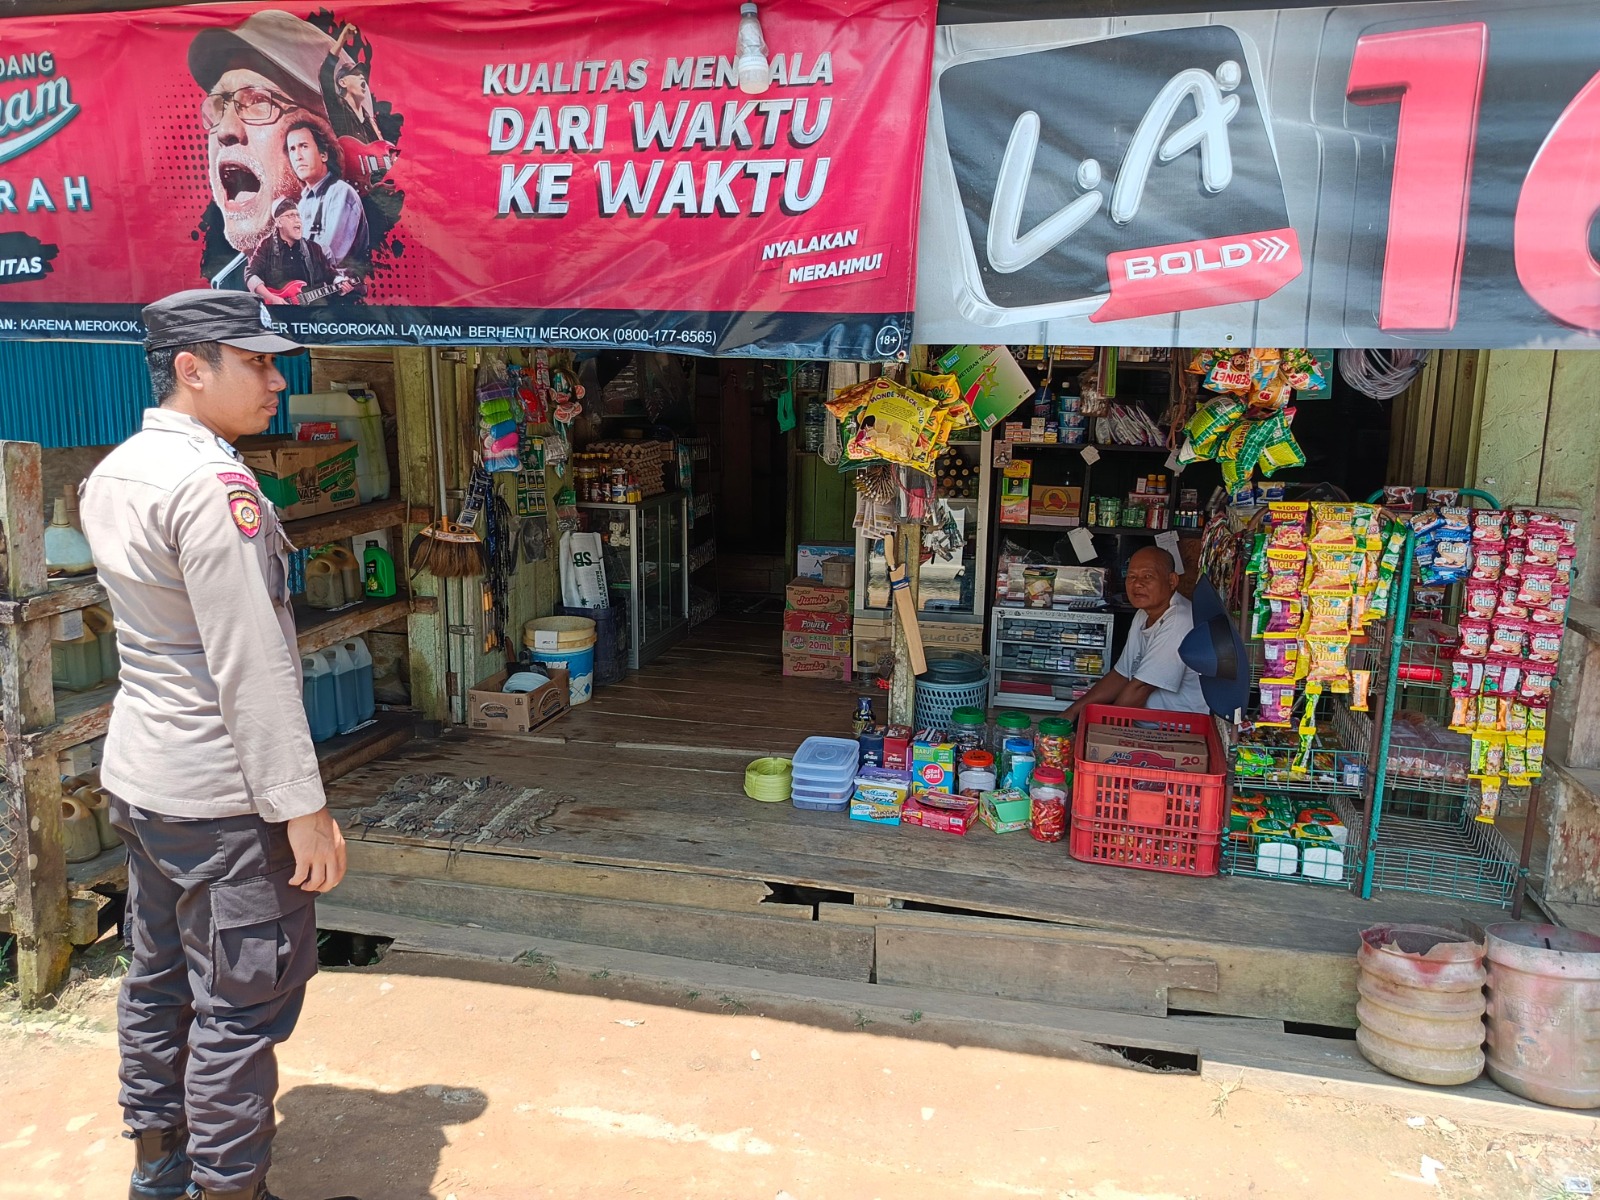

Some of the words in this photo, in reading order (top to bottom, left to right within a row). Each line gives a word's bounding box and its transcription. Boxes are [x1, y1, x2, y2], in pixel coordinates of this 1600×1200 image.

[483, 58, 649, 96] KUALITAS
[661, 51, 834, 91] MENALA
[489, 104, 608, 153] DARI
[629, 98, 833, 148] WAKTU
[498, 162, 573, 217] KE
[594, 157, 832, 216] WAKTU
[762, 228, 859, 261] NYALAKAN
[1125, 242, 1253, 282] BOLD
[788, 252, 883, 285] MERAHMU!
[20, 318, 72, 331] KARENA
[74, 320, 142, 333] MEROKOK,
[290, 322, 398, 336] TENGGOROKAN.
[400, 324, 462, 338] LAYANAN
[468, 326, 537, 340] BERHENTI
[539, 327, 610, 341] MEROKOK
[612, 329, 718, 345] (0800-177-6565)
[878, 336, 898, 347] 18+
[297, 486, 320, 500] VAPE
[1272, 512, 1304, 520] MIGELAS
[1478, 517, 1501, 526] Pilus
[1440, 543, 1465, 554] Pilus
[1532, 541, 1558, 552] Pilus
[1479, 557, 1501, 568] Pilus
[1525, 580, 1551, 592] Pilus
[1474, 597, 1496, 607] Pilus
[1312, 607, 1347, 617] YUMIE
[1496, 631, 1522, 642] Pilus
[1535, 641, 1560, 651] Pilus
[1112, 752, 1131, 760] Mie
[1181, 756, 1200, 766] 20
